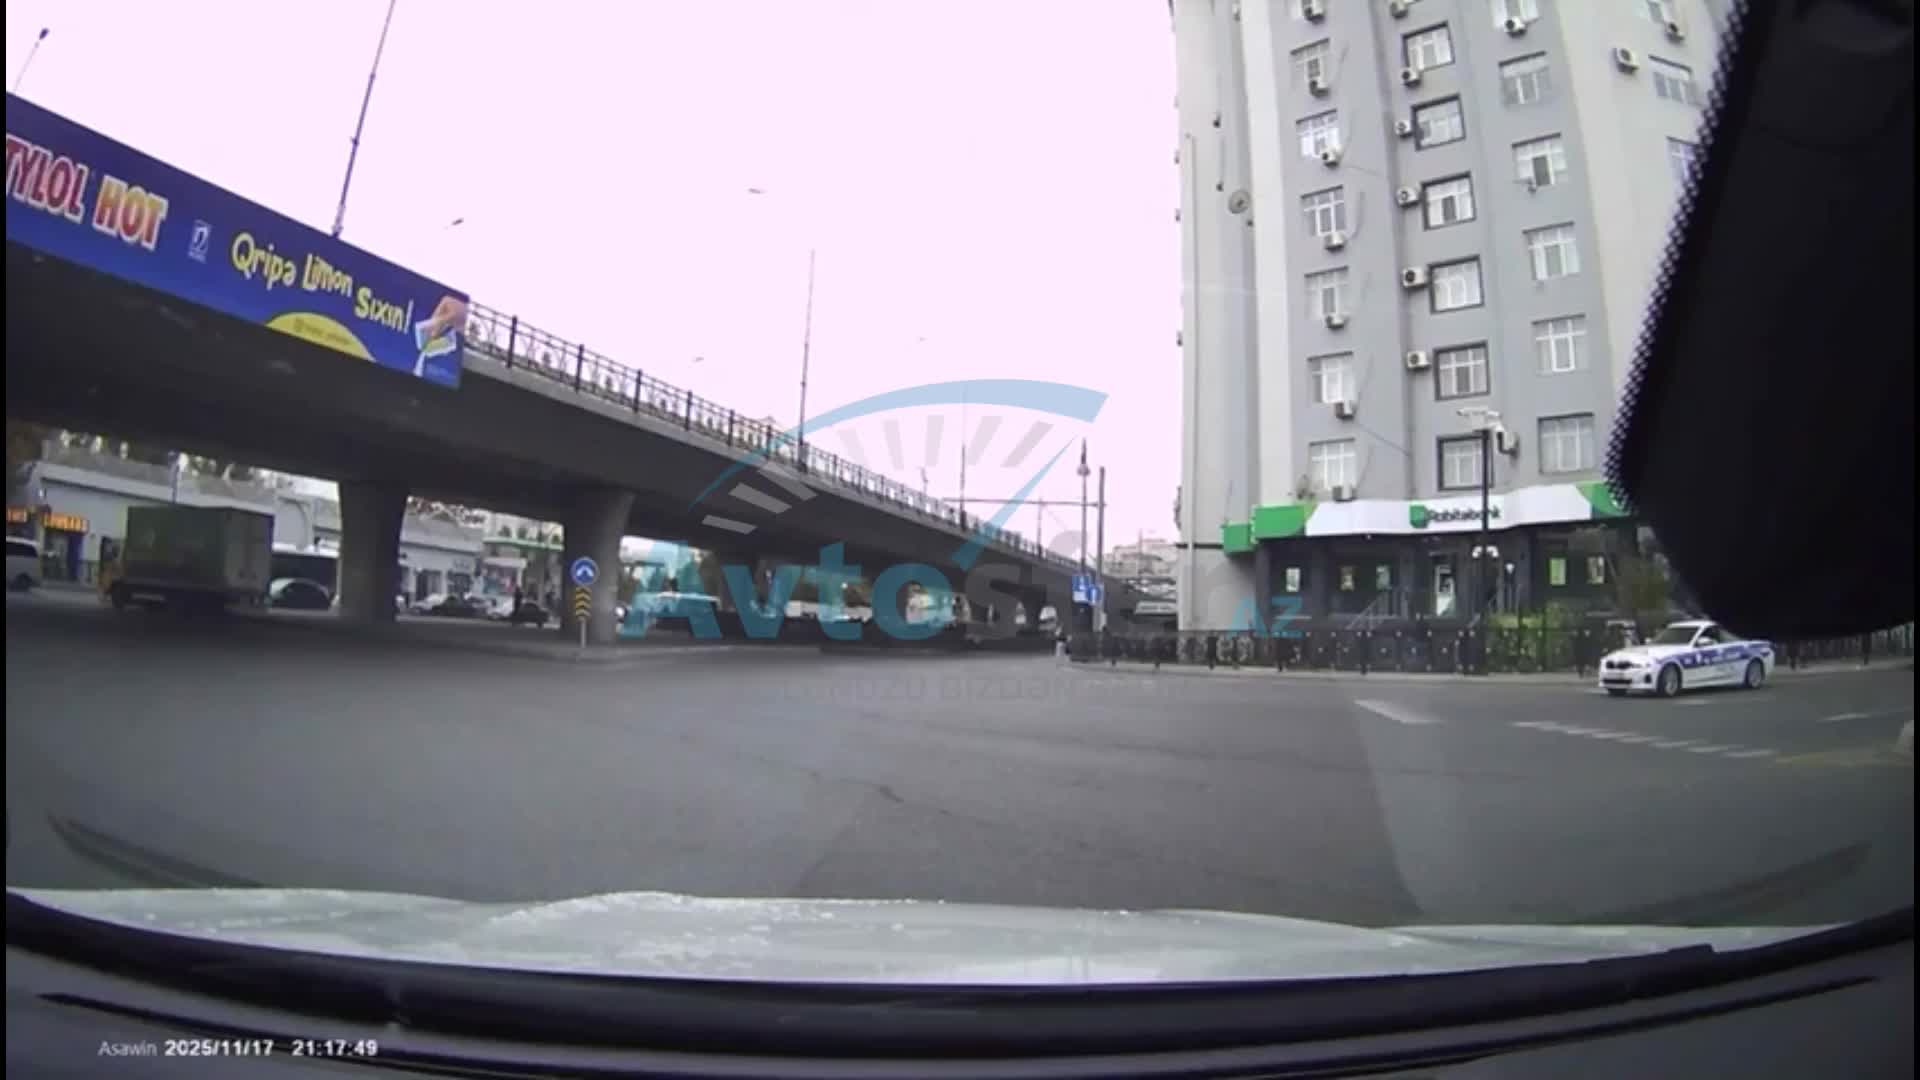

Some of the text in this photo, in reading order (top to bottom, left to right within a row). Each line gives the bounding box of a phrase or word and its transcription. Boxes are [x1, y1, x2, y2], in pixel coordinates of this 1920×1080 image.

[6, 133, 169, 252] TYLOL HOT
[232, 232, 353, 297] Qripə Limon
